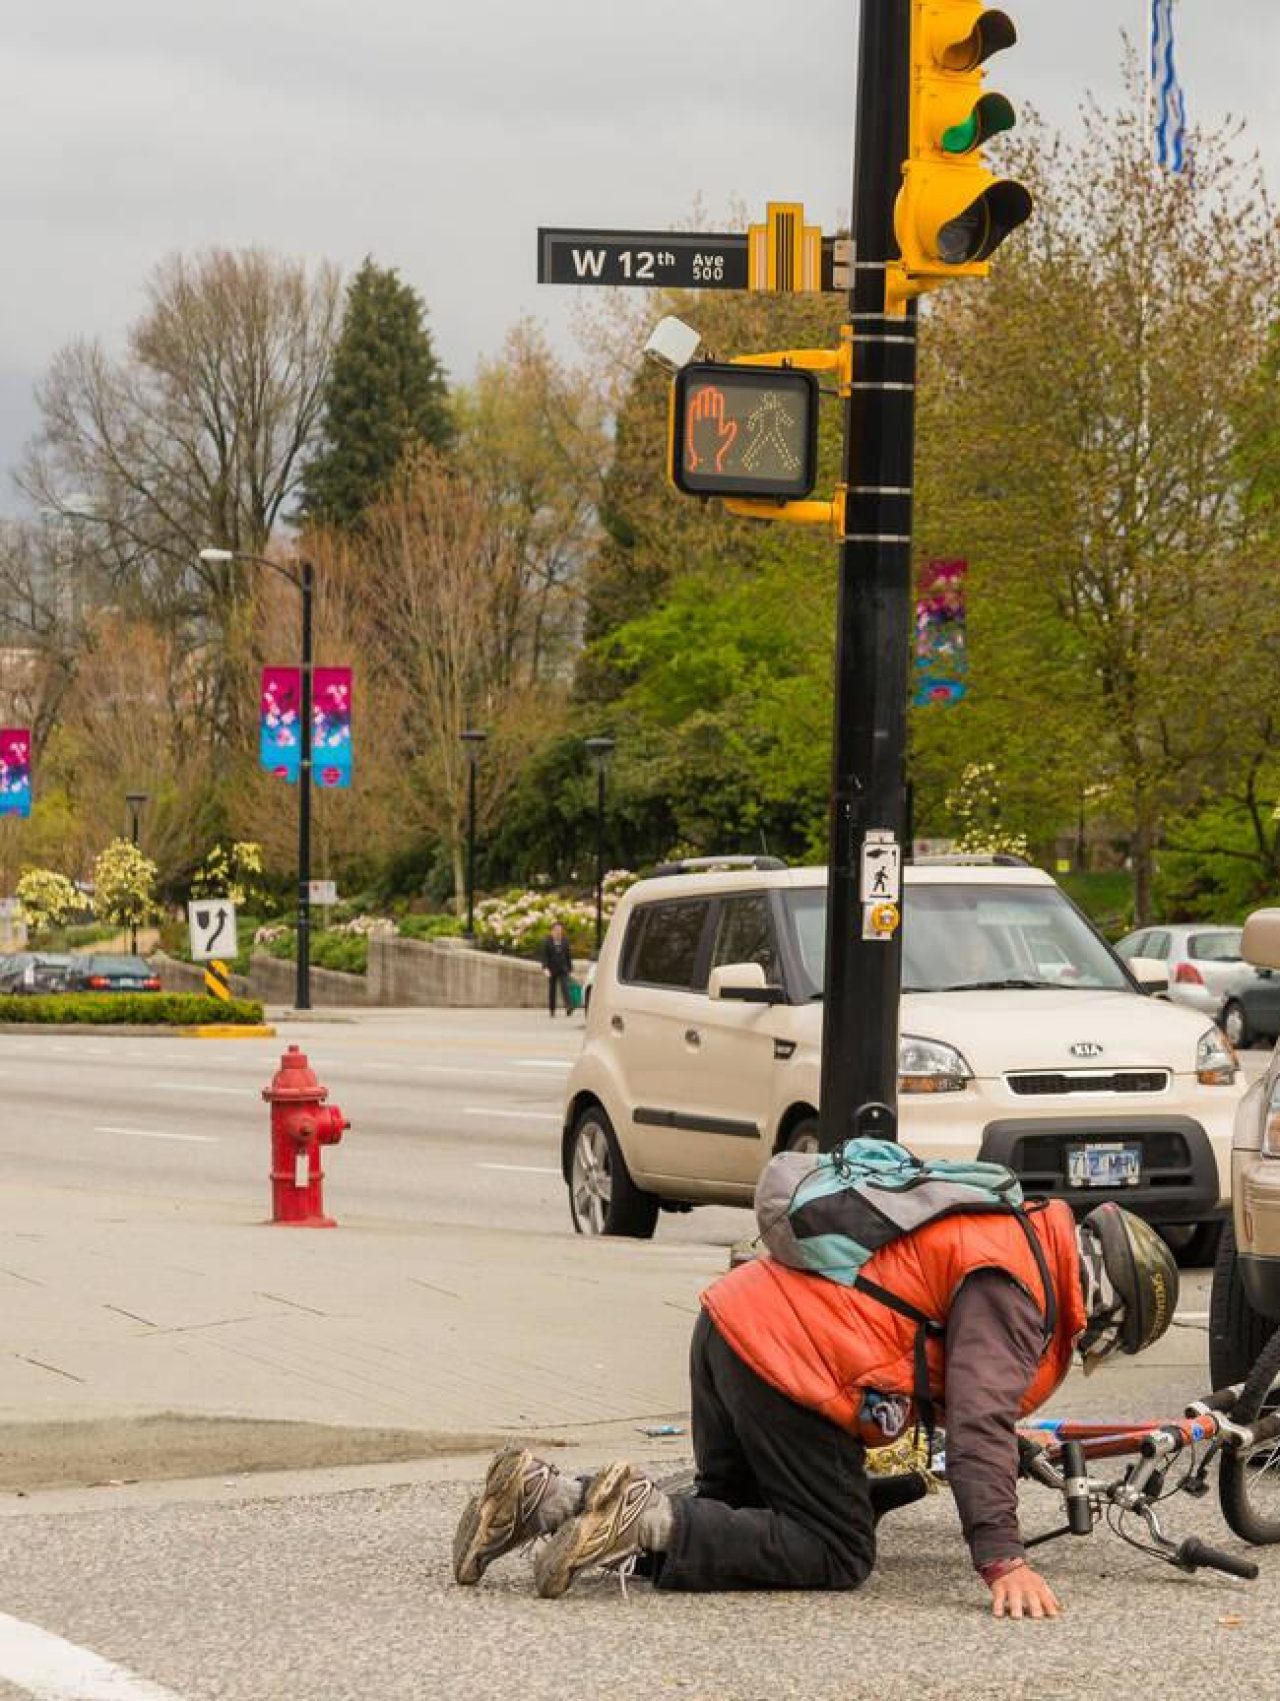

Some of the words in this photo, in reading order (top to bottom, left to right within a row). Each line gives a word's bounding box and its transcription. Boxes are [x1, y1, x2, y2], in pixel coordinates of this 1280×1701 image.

[571, 249, 607, 277] W
[617, 251, 677, 279] 12th
[692, 253, 725, 267] Ave
[692, 267, 725, 281] 500
